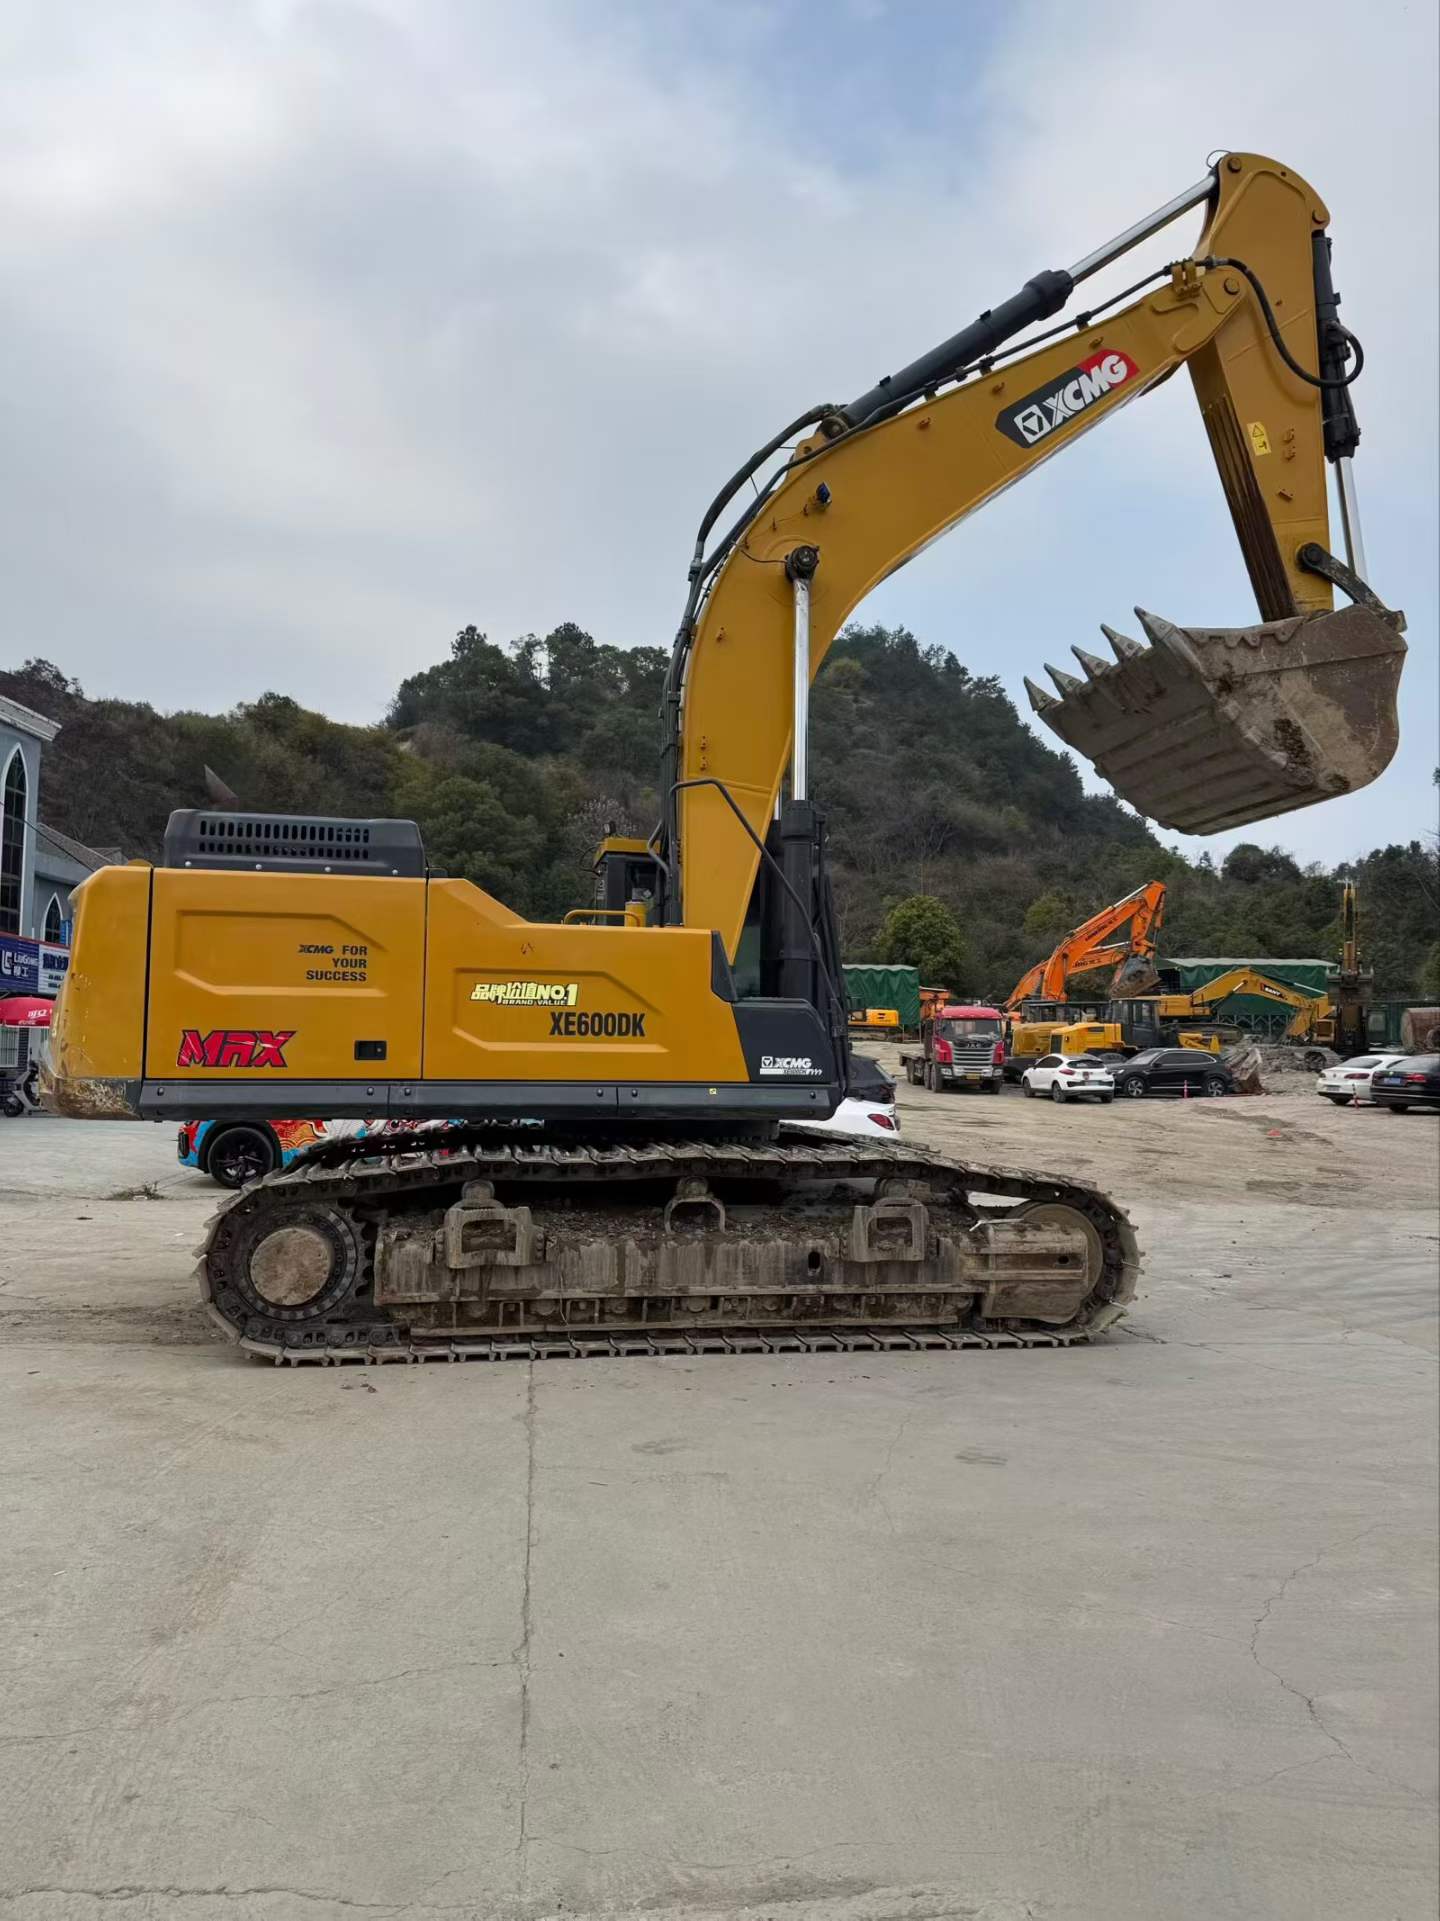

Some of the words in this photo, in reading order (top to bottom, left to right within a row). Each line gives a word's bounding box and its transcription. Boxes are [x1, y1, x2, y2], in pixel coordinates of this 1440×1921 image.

[1042, 355, 1128, 428] XCMG
[298, 945, 334, 954] XCMG
[342, 945, 368, 956] FOR
[332, 958, 367, 968] YOUR
[306, 970, 367, 982] SUCCESS
[549, 1012, 645, 1037] XE600DK
[176, 1030, 297, 1068] MAX
[774, 1057, 812, 1069] XCMG
